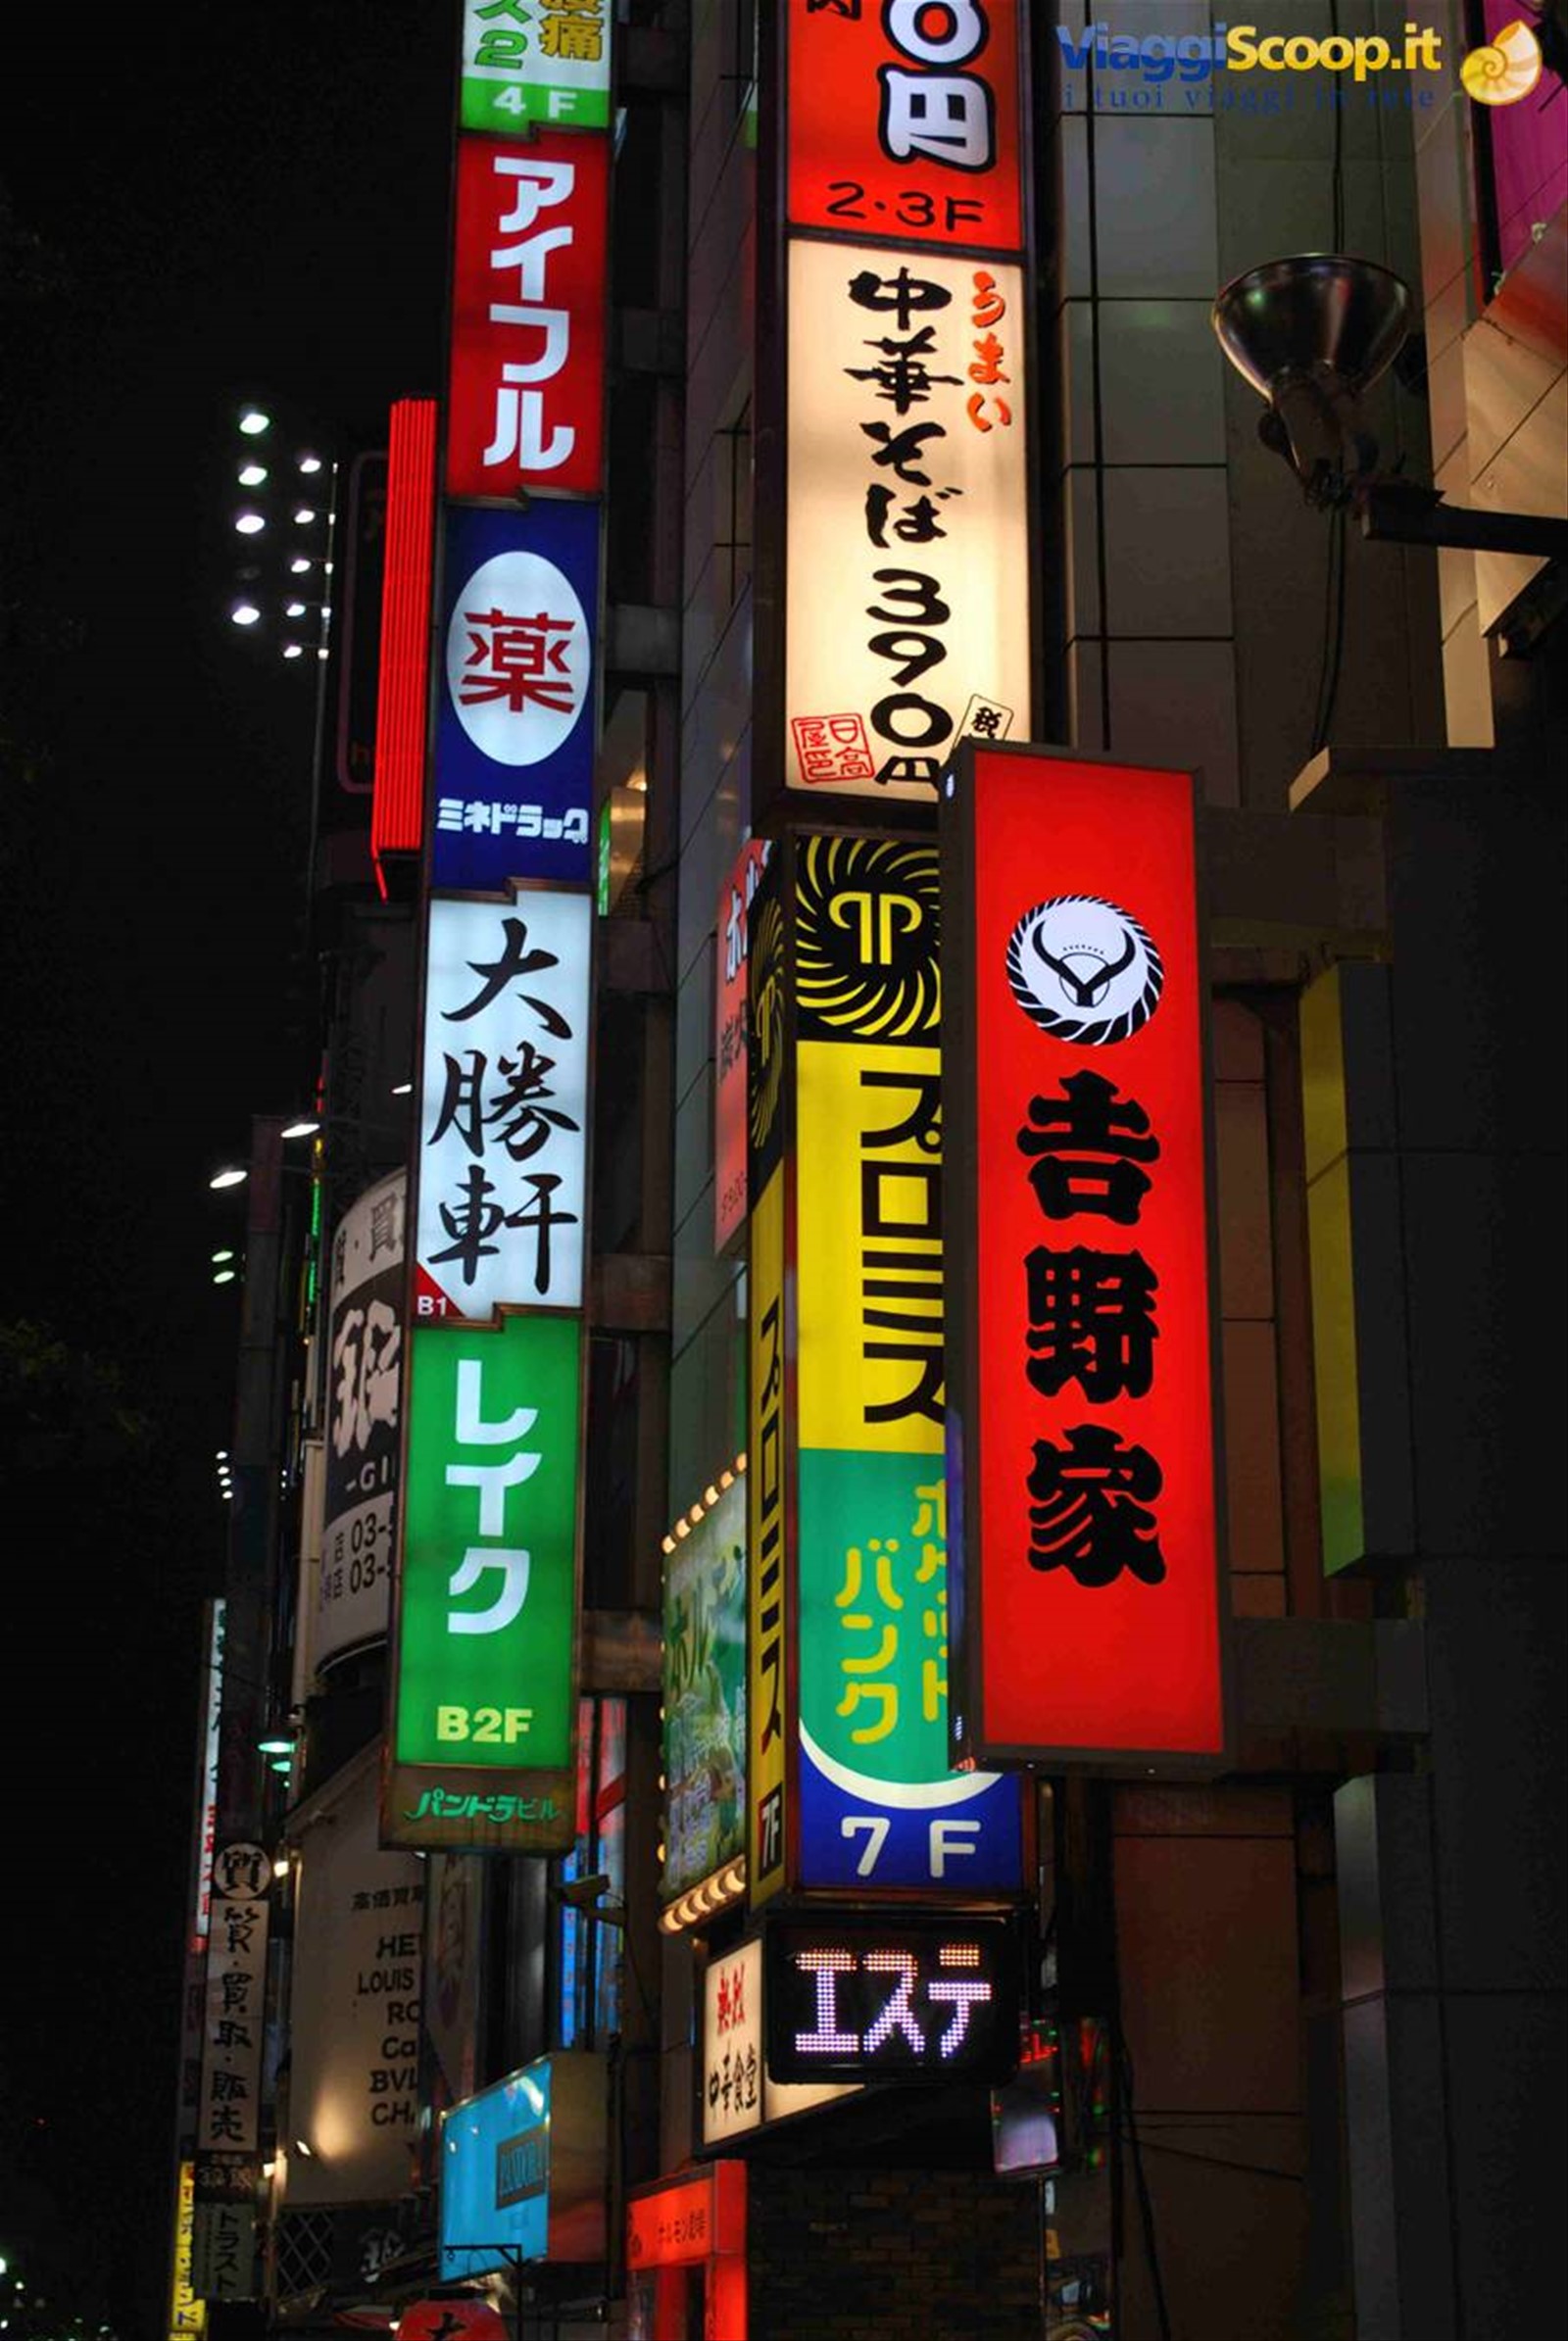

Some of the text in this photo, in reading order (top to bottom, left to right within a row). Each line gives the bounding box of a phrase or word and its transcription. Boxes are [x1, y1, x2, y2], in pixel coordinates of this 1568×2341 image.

[483, 156, 575, 470] アイフル
[965, 270, 1012, 433] うまい
[459, 608, 576, 714] 薬
[427, 917, 581, 1295] 大勝軒
[417, 1296, 448, 1317] B1
[1016, 1069, 1166, 1587] 吉野家
[351, 1512, 391, 1554] 03-
[445, 1359, 542, 1634] レイク
[760, 1293, 781, 1756] プロミス
[349, 1553, 390, 1595] 03-
[835, 1538, 904, 1744] バンク
[437, 1705, 533, 1744] B2F
[759, 1801, 781, 1871] 7F
[358, 1968, 415, 1995] LOUIS
[377, 1933, 423, 1959] HE
[795, 1943, 992, 2058] エステ
